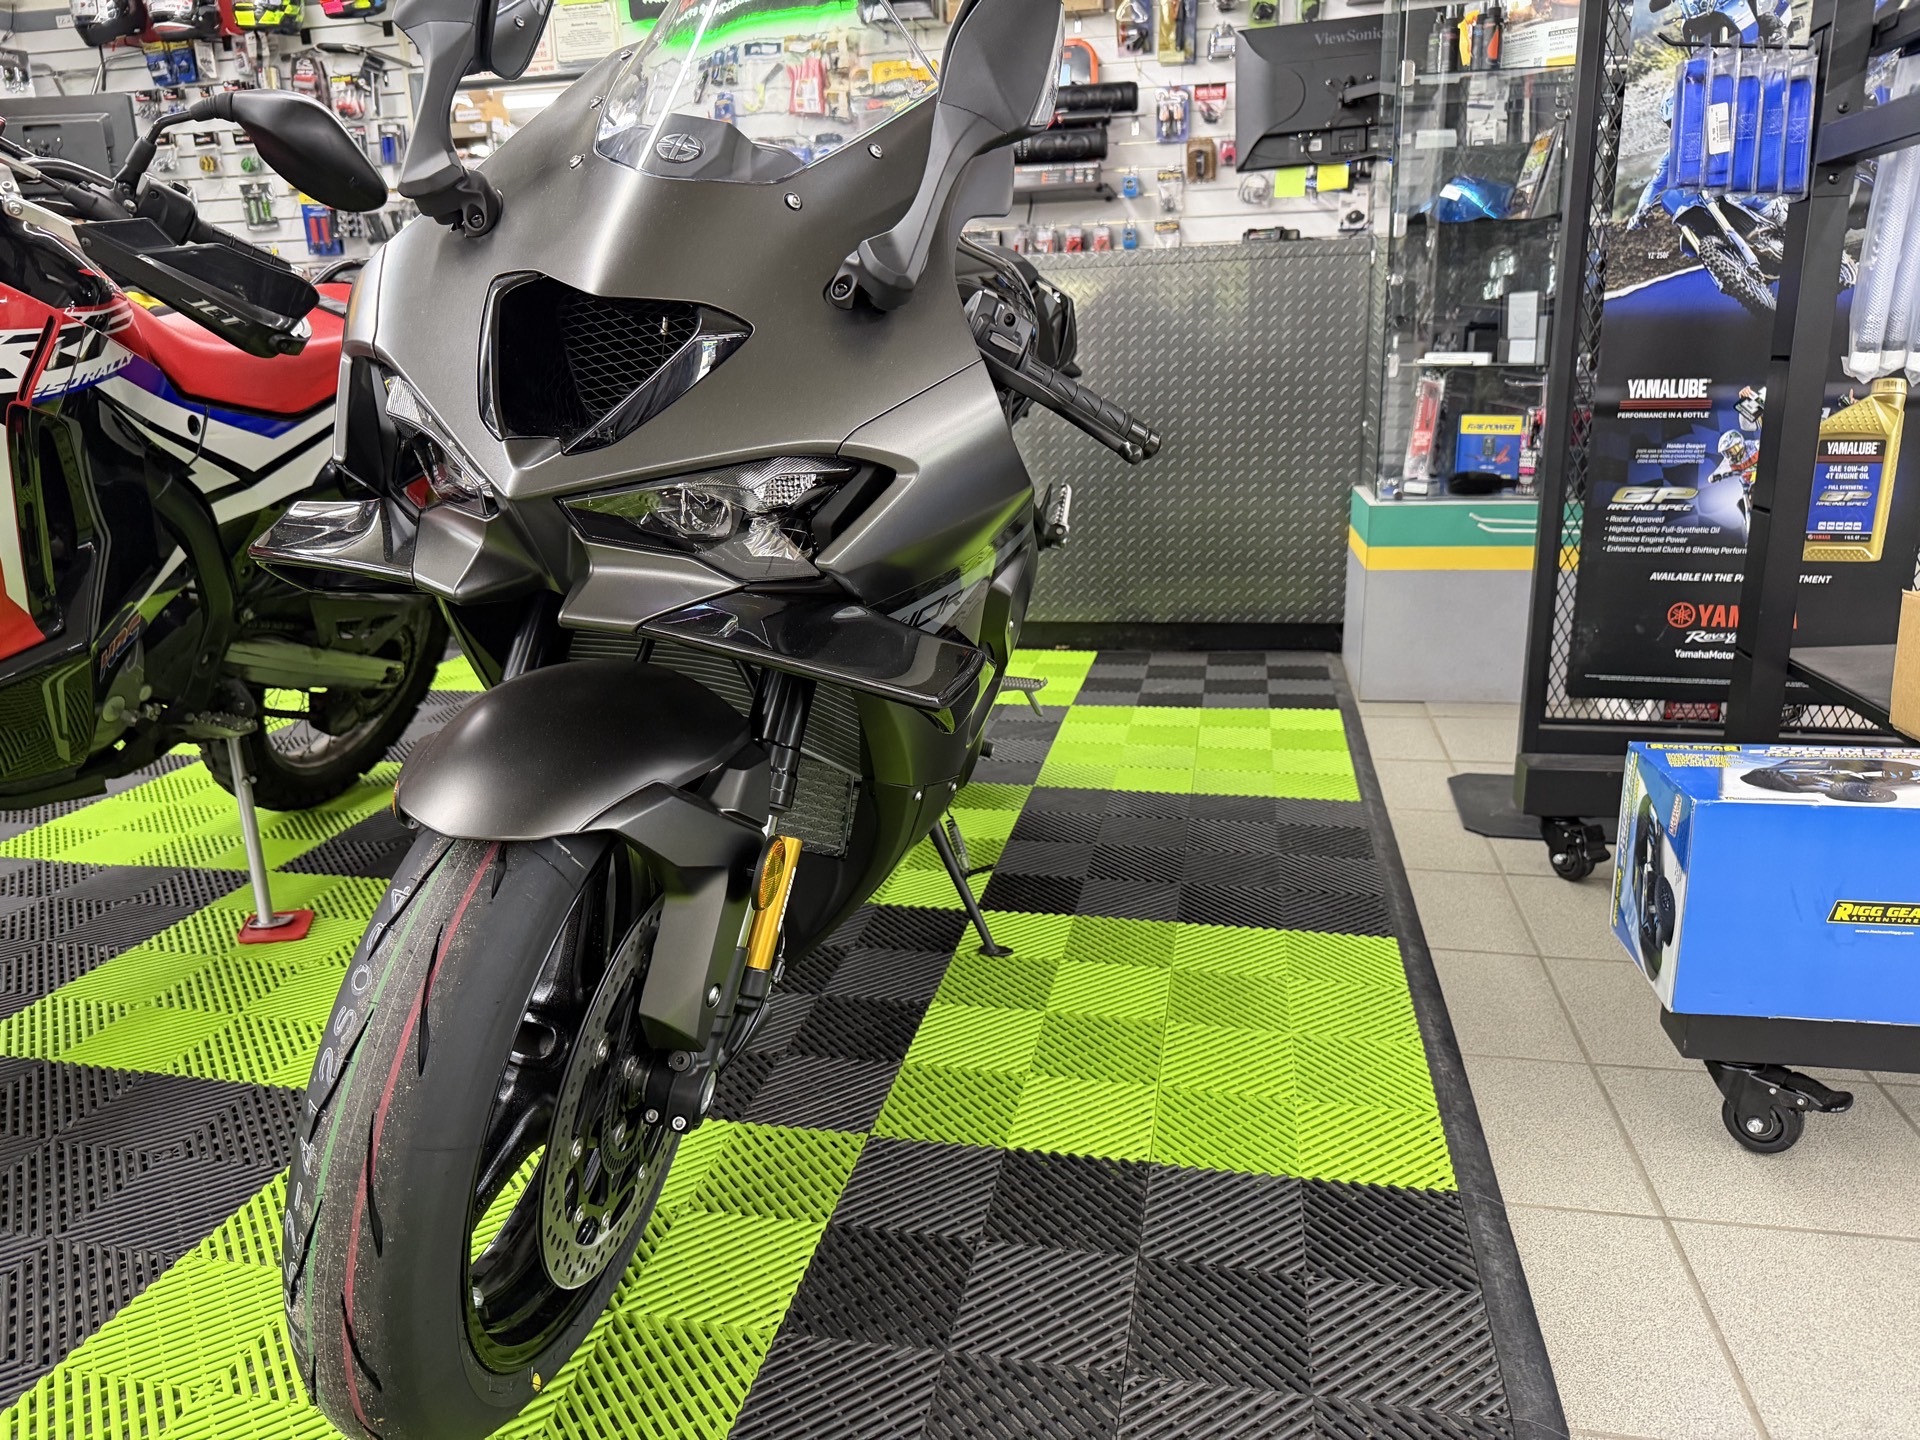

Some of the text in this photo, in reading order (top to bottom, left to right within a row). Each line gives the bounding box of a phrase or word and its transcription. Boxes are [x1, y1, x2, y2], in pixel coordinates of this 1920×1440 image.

[1314, 27, 1385, 46] ViewSonic
[1628, 379, 1708, 399] YAMALUBE
[1827, 442, 1878, 455] YAMALUBE
[1612, 487, 1699, 503] GP
[1609, 526, 1635, 534] Highest
[1636, 526, 1660, 534] Quality
[1661, 527, 1709, 535] Full-Synthetic
[1641, 536, 1664, 544] Engine
[1607, 545, 1637, 553] Enhance
[1662, 546, 1684, 554] Clutch
[1692, 546, 1720, 555] Shifting
[1650, 571, 1701, 582] AVAILABLE
[1701, 573, 1713, 582] IN
[1714, 573, 1733, 582] THE
[1833, 903, 1885, 921] RIGG
